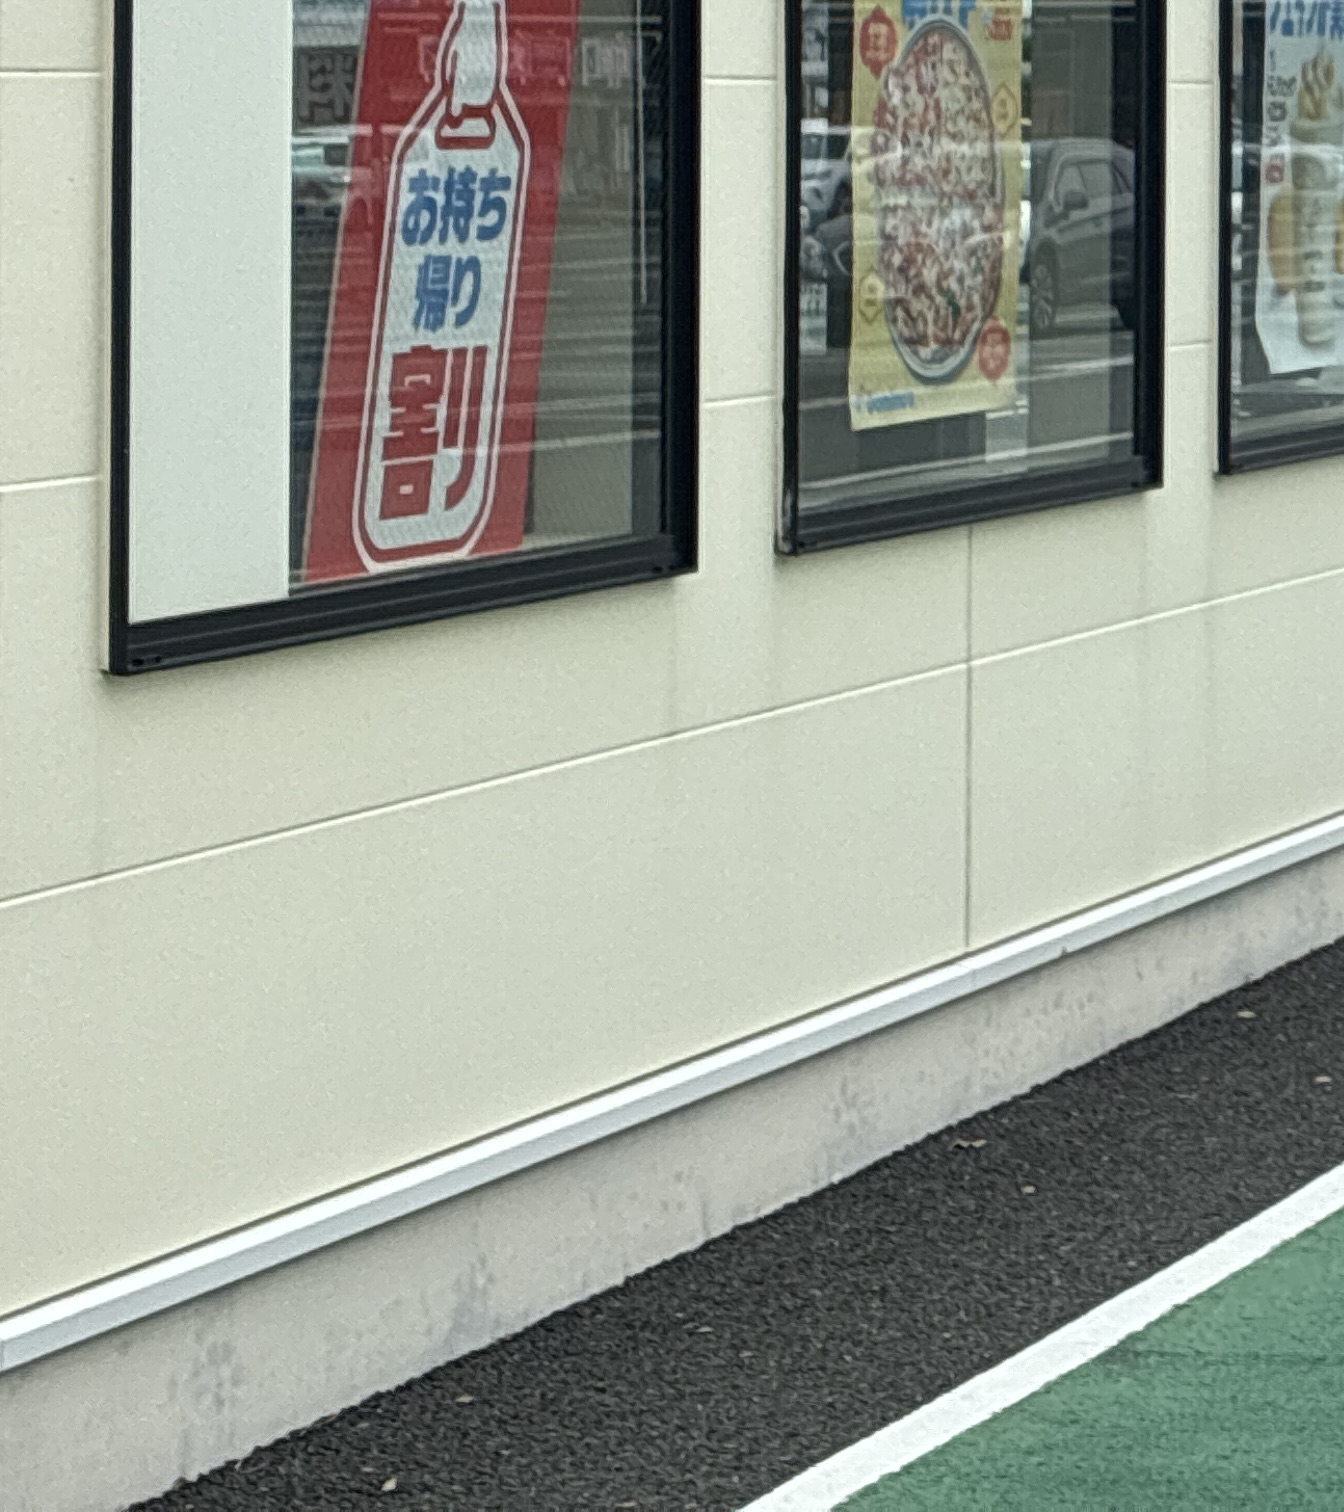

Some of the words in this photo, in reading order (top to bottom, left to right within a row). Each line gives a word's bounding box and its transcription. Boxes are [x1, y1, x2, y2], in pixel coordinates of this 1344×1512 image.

[401, 166, 511, 248] お持ち
[413, 253, 482, 334] 帰り
[379, 343, 489, 522] 割
